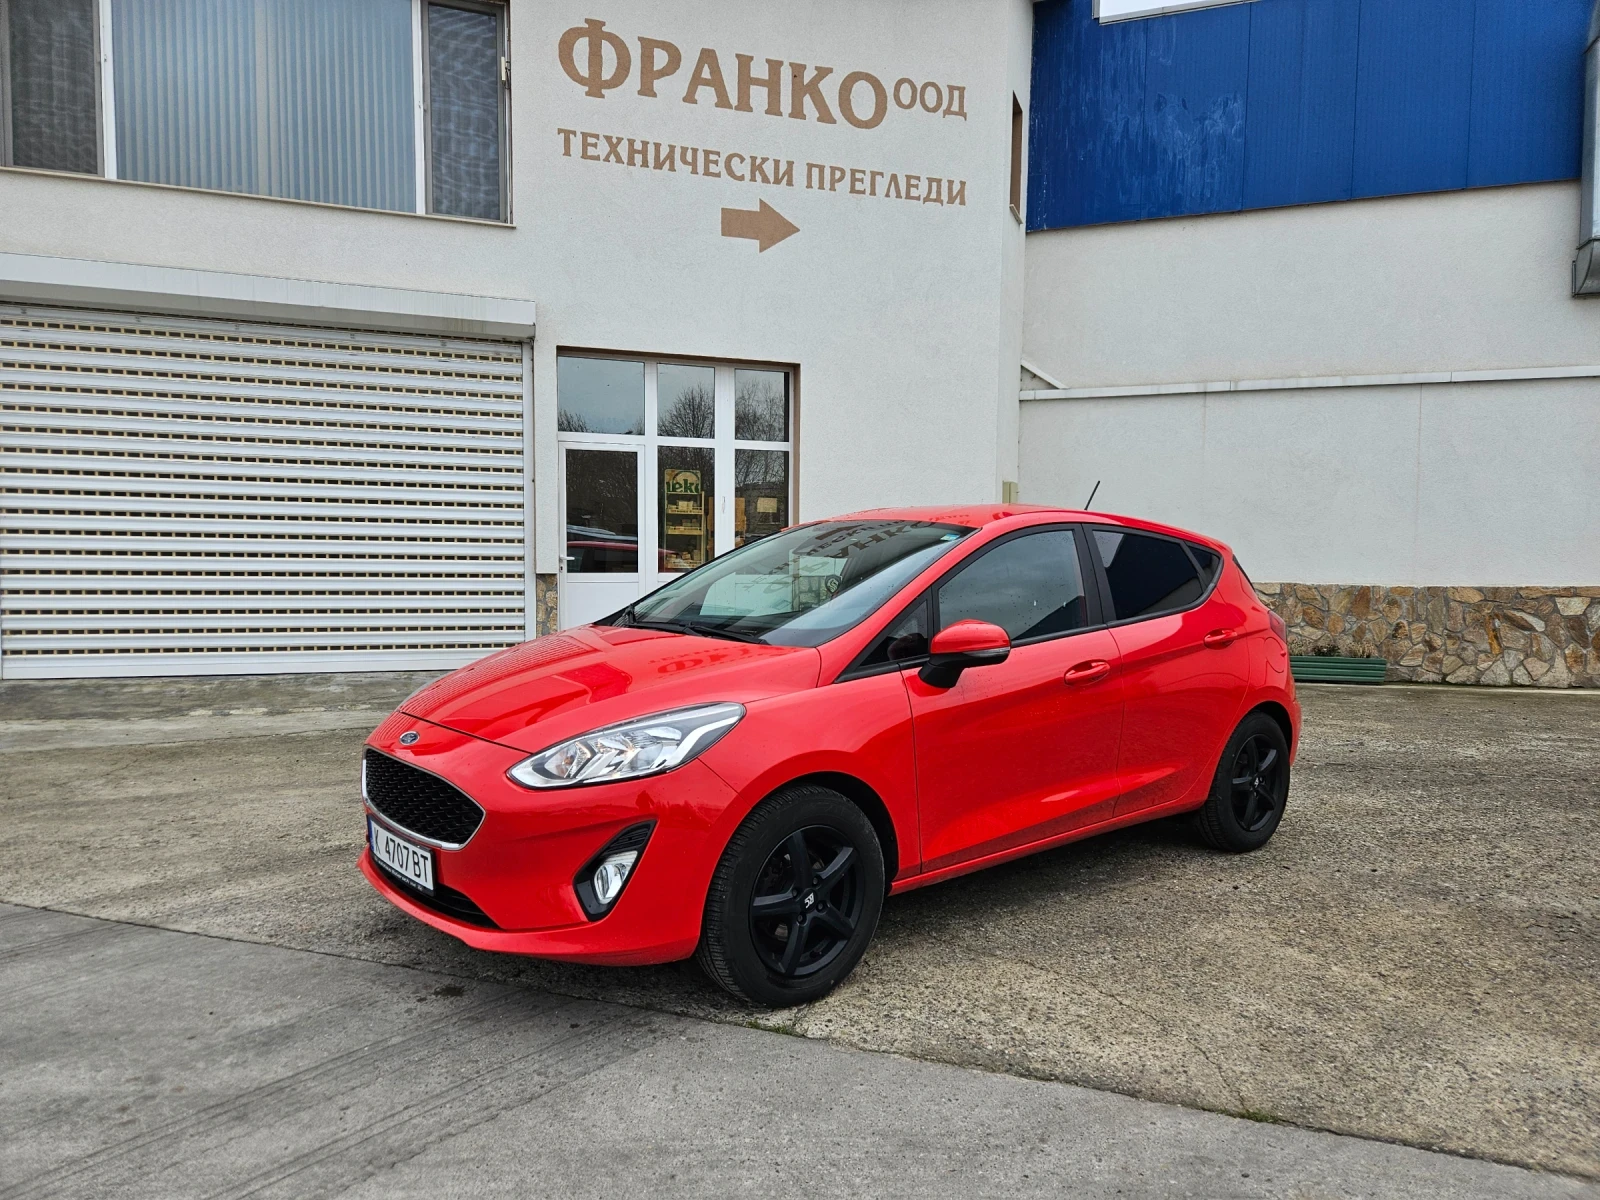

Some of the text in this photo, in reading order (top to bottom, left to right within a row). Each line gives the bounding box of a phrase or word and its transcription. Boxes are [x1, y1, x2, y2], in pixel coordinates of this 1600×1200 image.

[557, 17, 967, 130] ФРАНКО ООД
[557, 127, 967, 207] ТЕХНИЧЕСКИ ПРЕГЛЕДИ
[385, 835, 410, 872] 4707
[412, 849, 429, 883] BT
